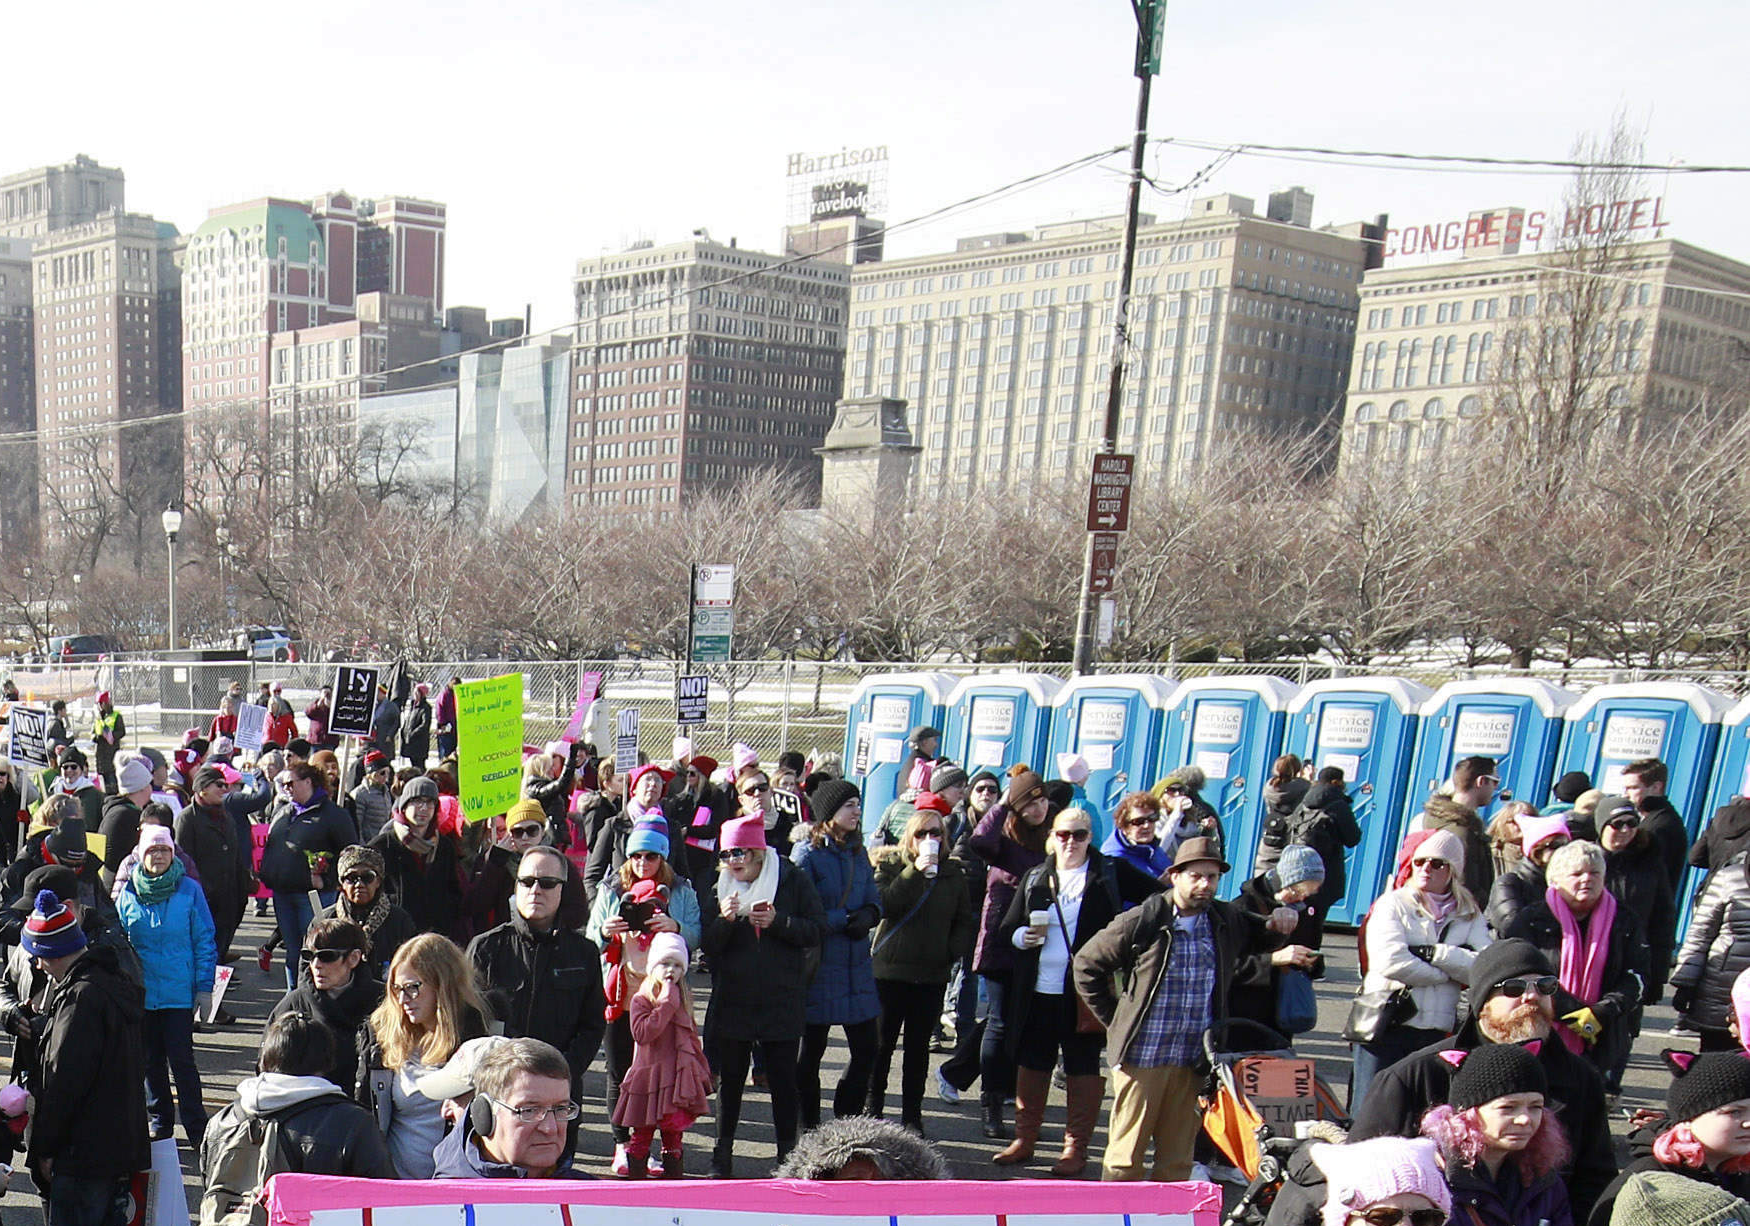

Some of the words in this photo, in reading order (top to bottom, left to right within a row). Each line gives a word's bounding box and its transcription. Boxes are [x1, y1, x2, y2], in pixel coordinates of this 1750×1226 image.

[787, 145, 889, 177] Harrison
[1381, 211, 1546, 258] CONGRESS
[1562, 196, 1670, 238] HOTEL
[1100, 459, 1127, 473] HAROLD
[1094, 473, 1130, 485] WASHINGTON
[1097, 486, 1124, 499] LIBRARY
[1097, 500, 1122, 513] CENTER
[471, 687, 481, 699] you
[679, 677, 707, 698] NO!
[463, 702, 476, 715] said
[476, 705, 486, 716] you
[487, 698, 501, 711] would
[501, 699, 512, 712] join
[618, 709, 638, 737] NO!
[1461, 717, 1510, 731] Service
[482, 767, 519, 782] REBELLION
[463, 795, 484, 811] NOW
[496, 791, 505, 803] the
[1257, 1103, 1315, 1122] TIME
